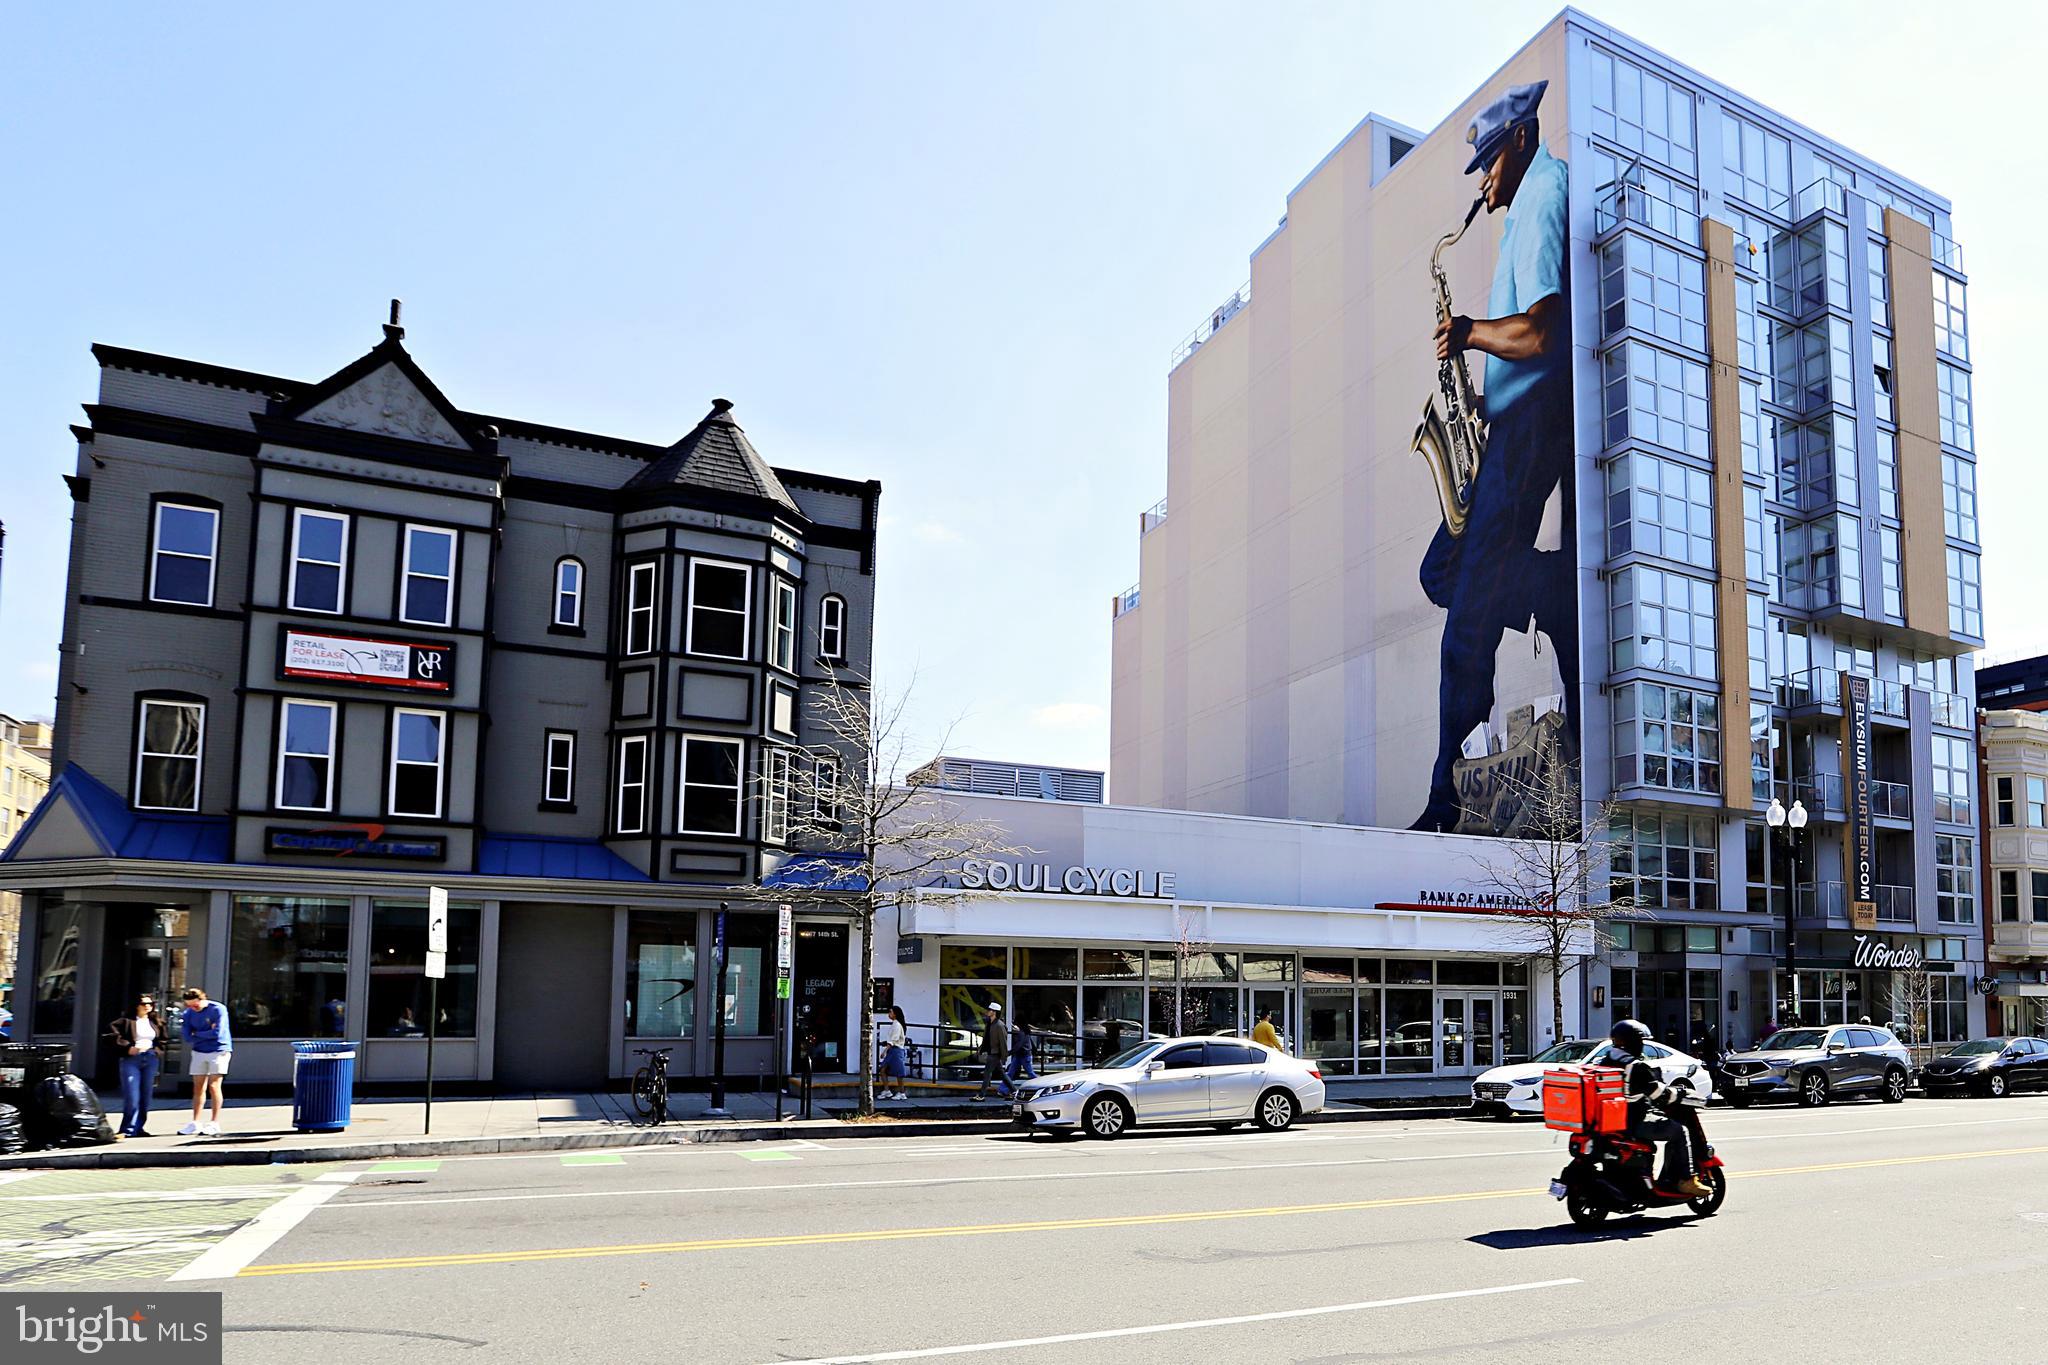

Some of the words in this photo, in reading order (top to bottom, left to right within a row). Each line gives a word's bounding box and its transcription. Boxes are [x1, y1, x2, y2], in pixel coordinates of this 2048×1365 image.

[293, 639, 326, 650] RETAIL
[292, 647, 314, 656] FOR
[315, 650, 345, 660] LEASE
[1460, 767, 1483, 799] US
[1855, 702, 1871, 900] ELYSIUMFOURTEEN.COM
[960, 860, 1177, 898] SOULCYCLE
[1419, 890, 1455, 903] BANK
[1458, 892, 1474, 903] OF
[1476, 893, 1532, 906] AMERICA
[1854, 935, 1922, 968] Wonder
[805, 979, 835, 987] LEGACY
[1824, 980, 1857, 994] Woder
[805, 987, 816, 995] DC
